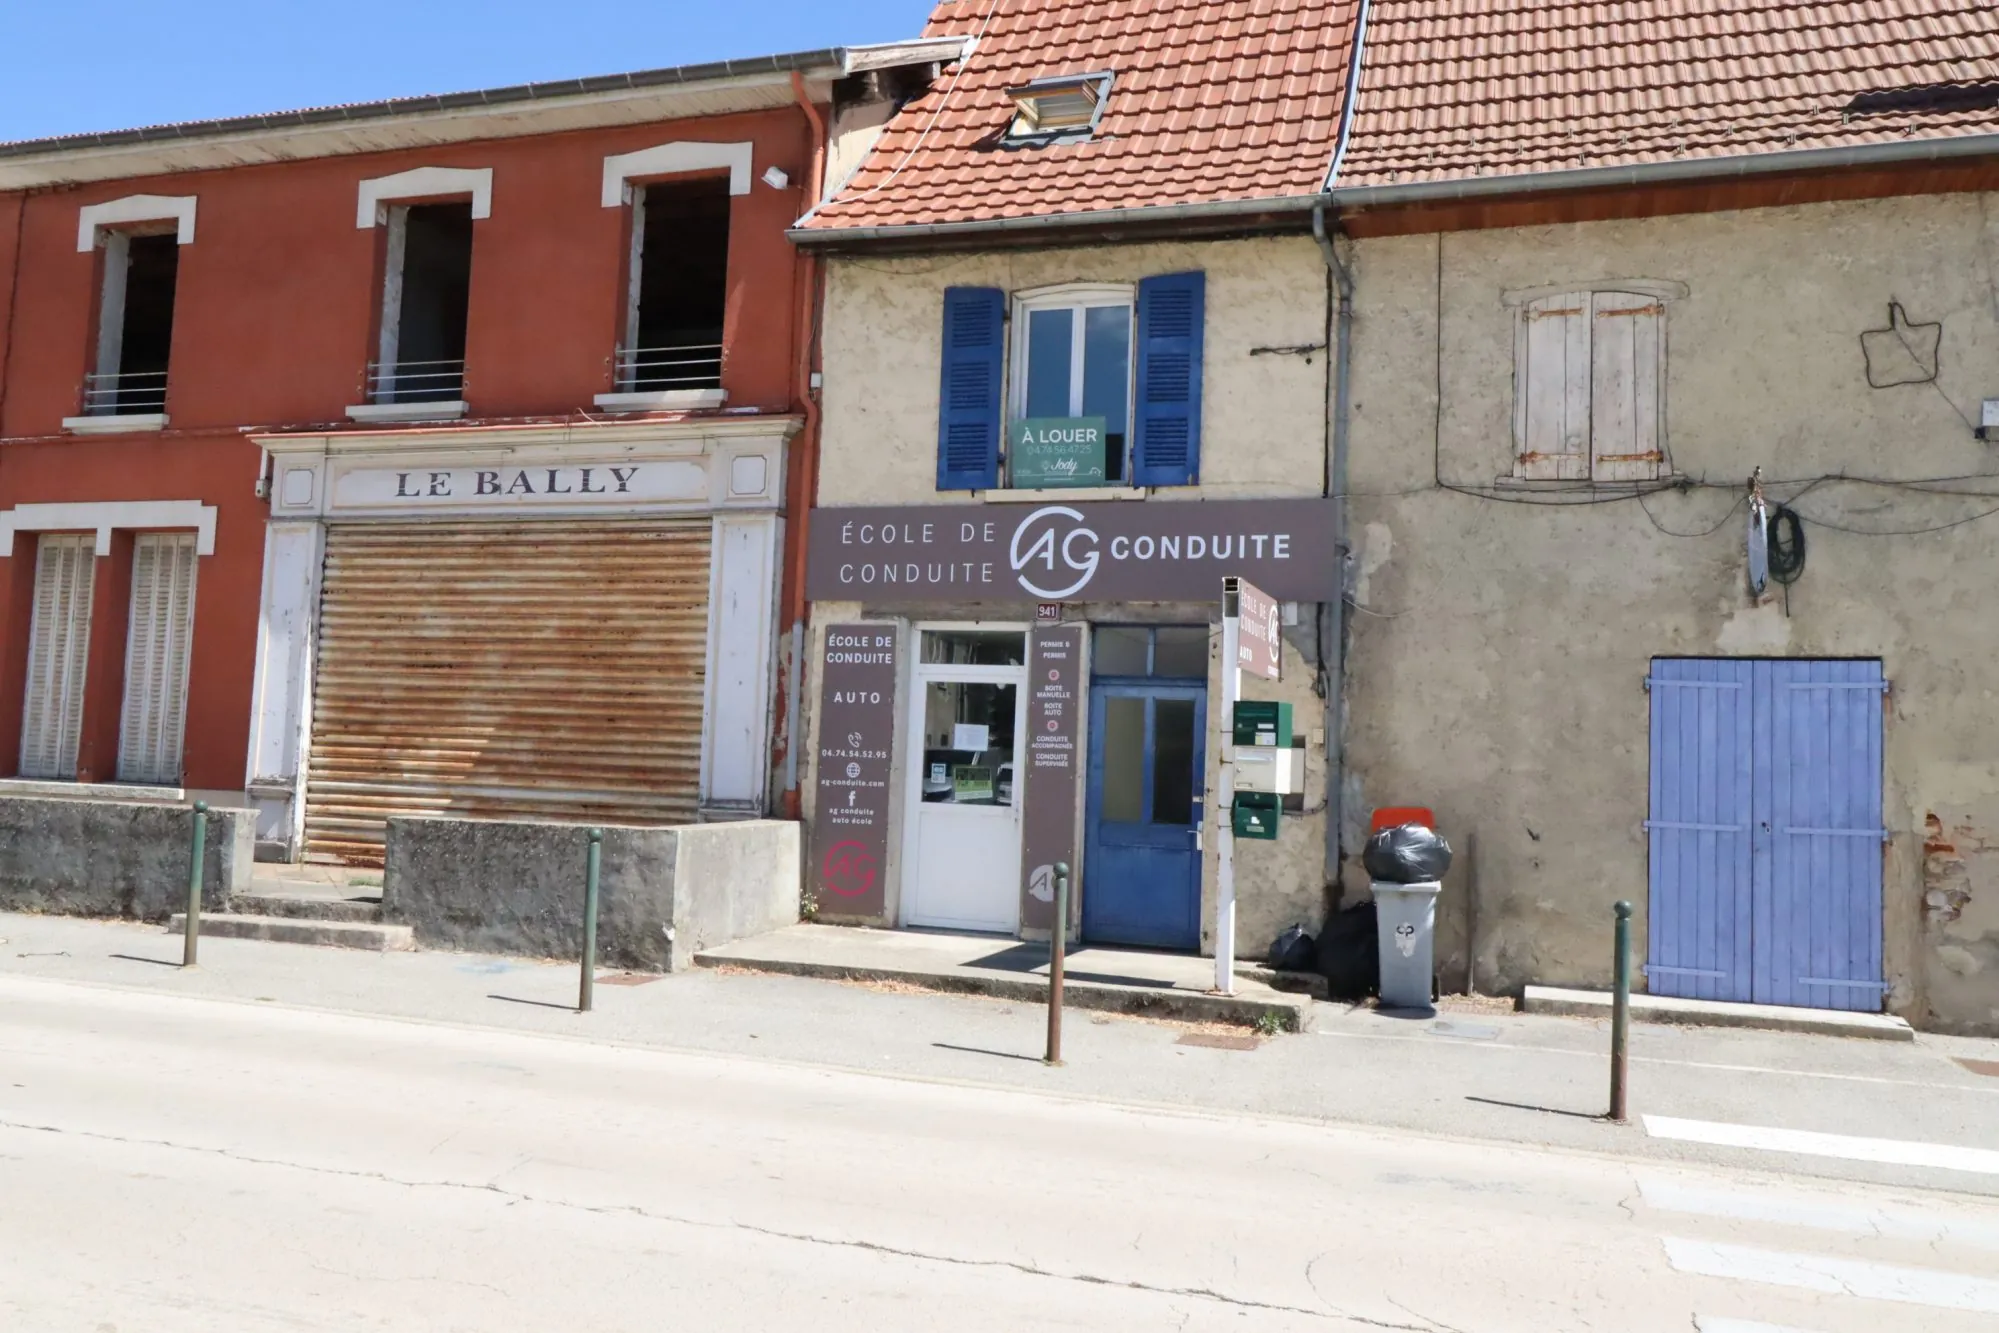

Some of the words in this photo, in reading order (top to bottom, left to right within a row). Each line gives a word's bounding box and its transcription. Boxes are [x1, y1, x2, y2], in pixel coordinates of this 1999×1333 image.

[1022, 426, 1034, 443] À
[1040, 428, 1097, 443] LOUER
[1051, 458, 1077, 475] Jody
[395, 472, 452, 497] LE
[473, 467, 640, 495] BALLY
[842, 521, 934, 544] ÉCOLE
[961, 523, 995, 543] DE
[1111, 534, 1290, 559] CONDUITE
[840, 563, 993, 583] CONDUITE
[1039, 606, 1055, 617] 941
[829, 633, 869, 647] ÉCOLE
[875, 636, 892, 647] DE
[827, 652, 892, 664] CONDUITE
[834, 691, 880, 704] AUTO
